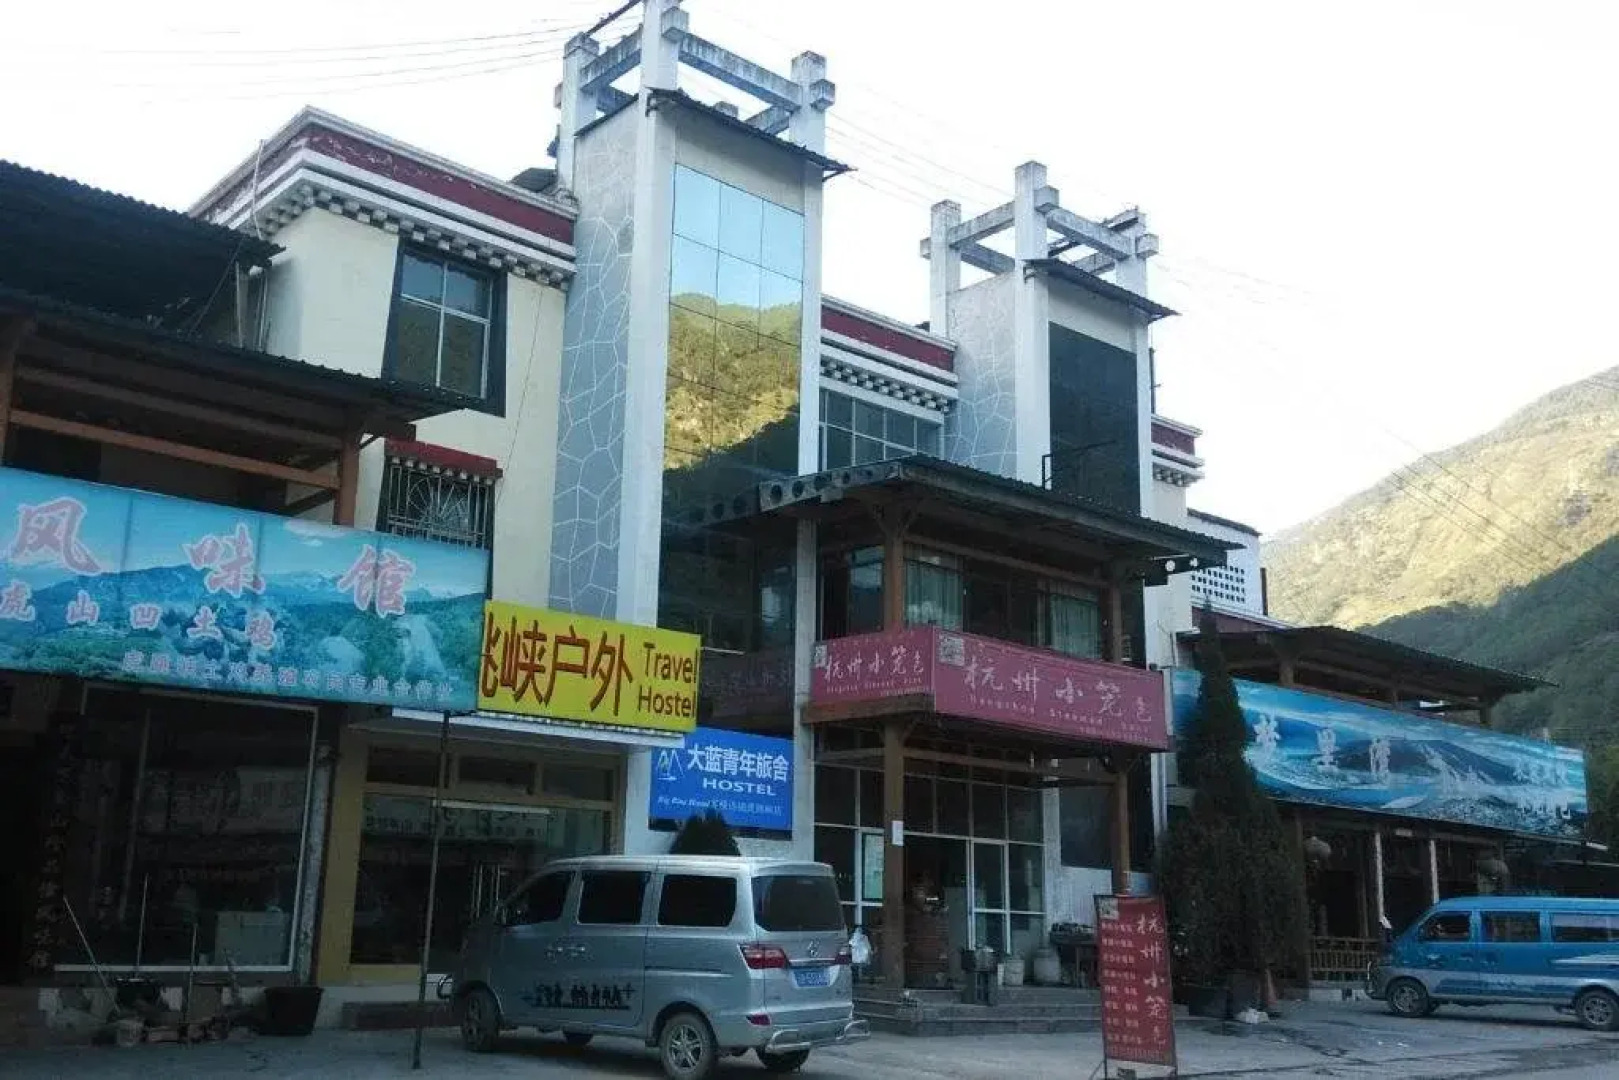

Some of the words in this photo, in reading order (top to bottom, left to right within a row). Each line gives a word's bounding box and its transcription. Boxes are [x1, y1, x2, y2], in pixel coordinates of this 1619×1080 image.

[3, 496, 417, 618] 风味馆
[643, 641, 698, 684] Travel
[637, 686, 696, 718] Hostel
[688, 743, 790, 785] 大蓝青年旅舍
[702, 778, 777, 797] HOSTEL
